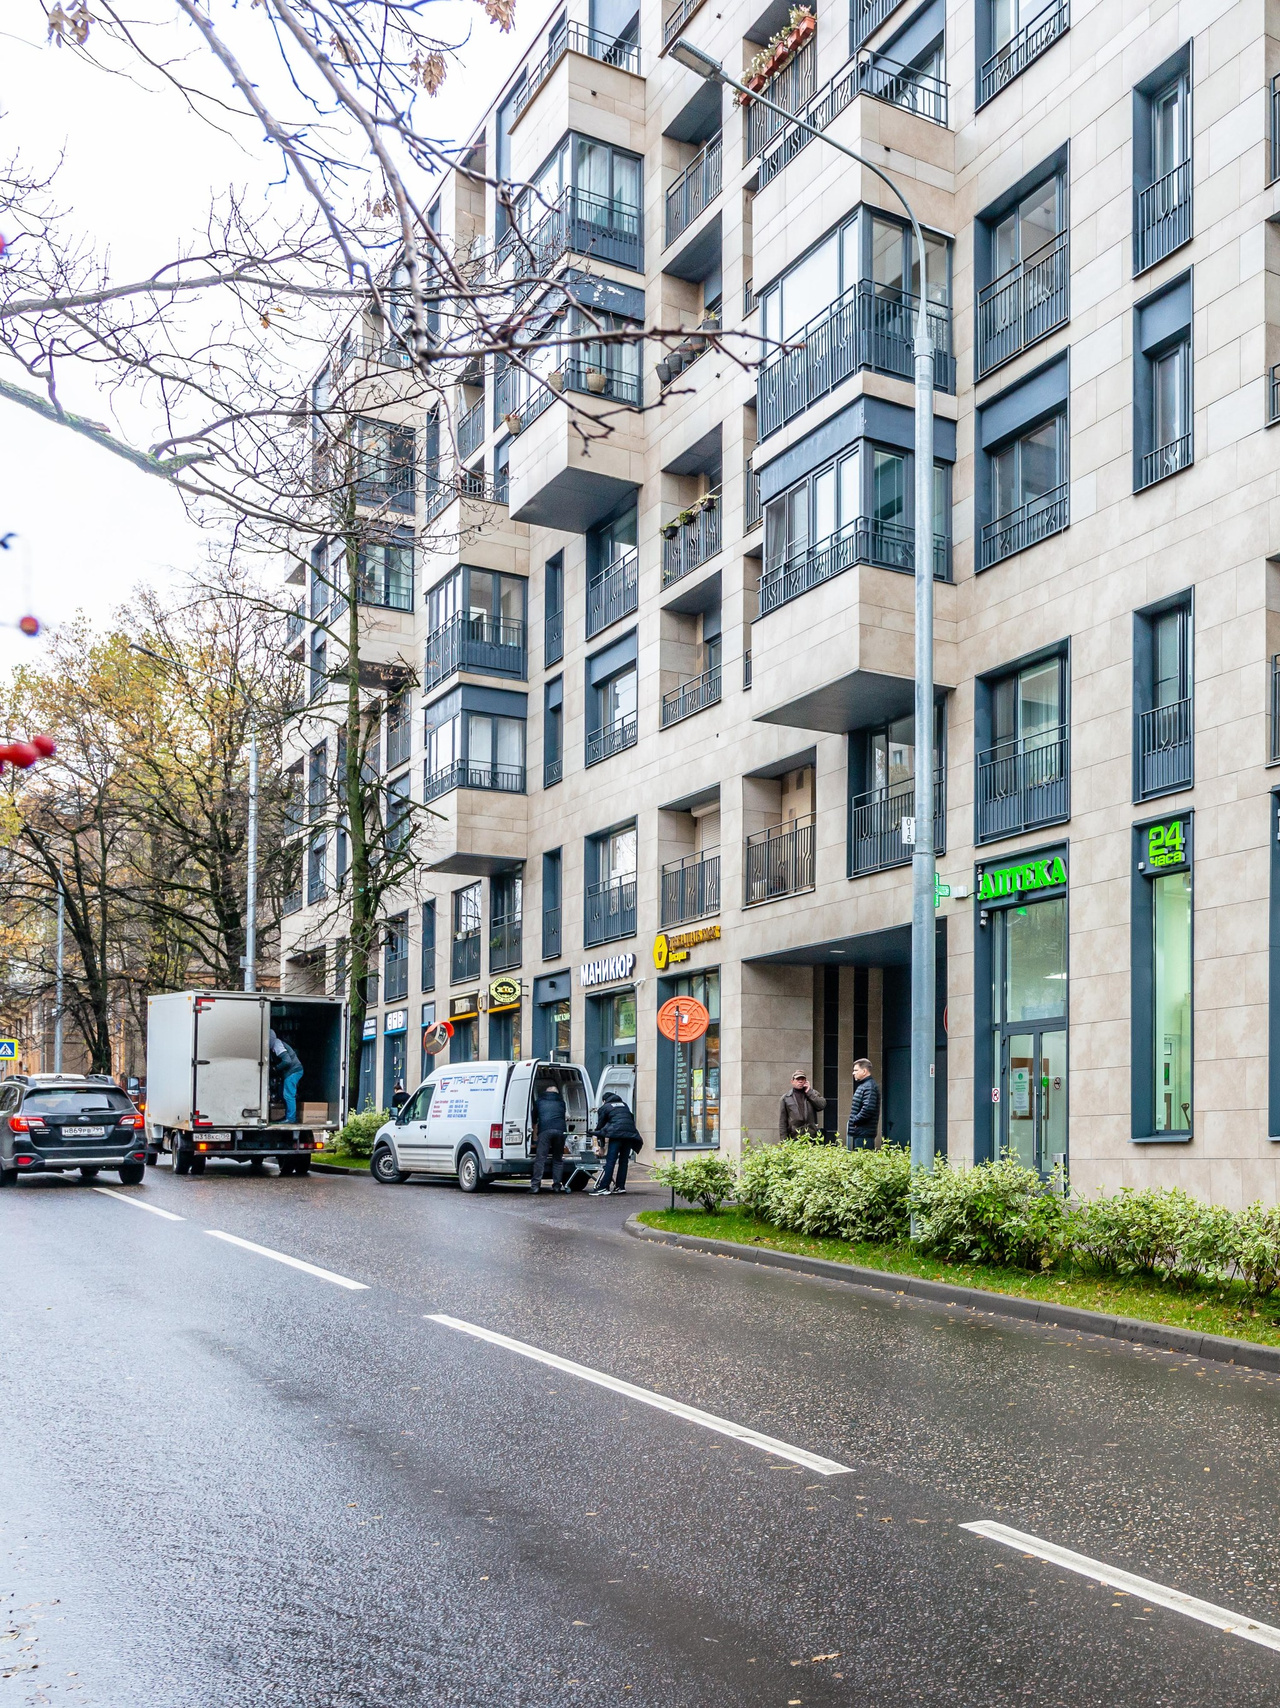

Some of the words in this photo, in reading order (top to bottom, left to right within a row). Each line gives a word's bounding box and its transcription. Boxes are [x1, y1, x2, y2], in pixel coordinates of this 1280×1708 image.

[1149, 821, 1183, 857] 24
[1149, 851, 1184, 867] часа
[978, 856, 1068, 900] АПТЕКА
[581, 953, 635, 987] МАНИКЮР
